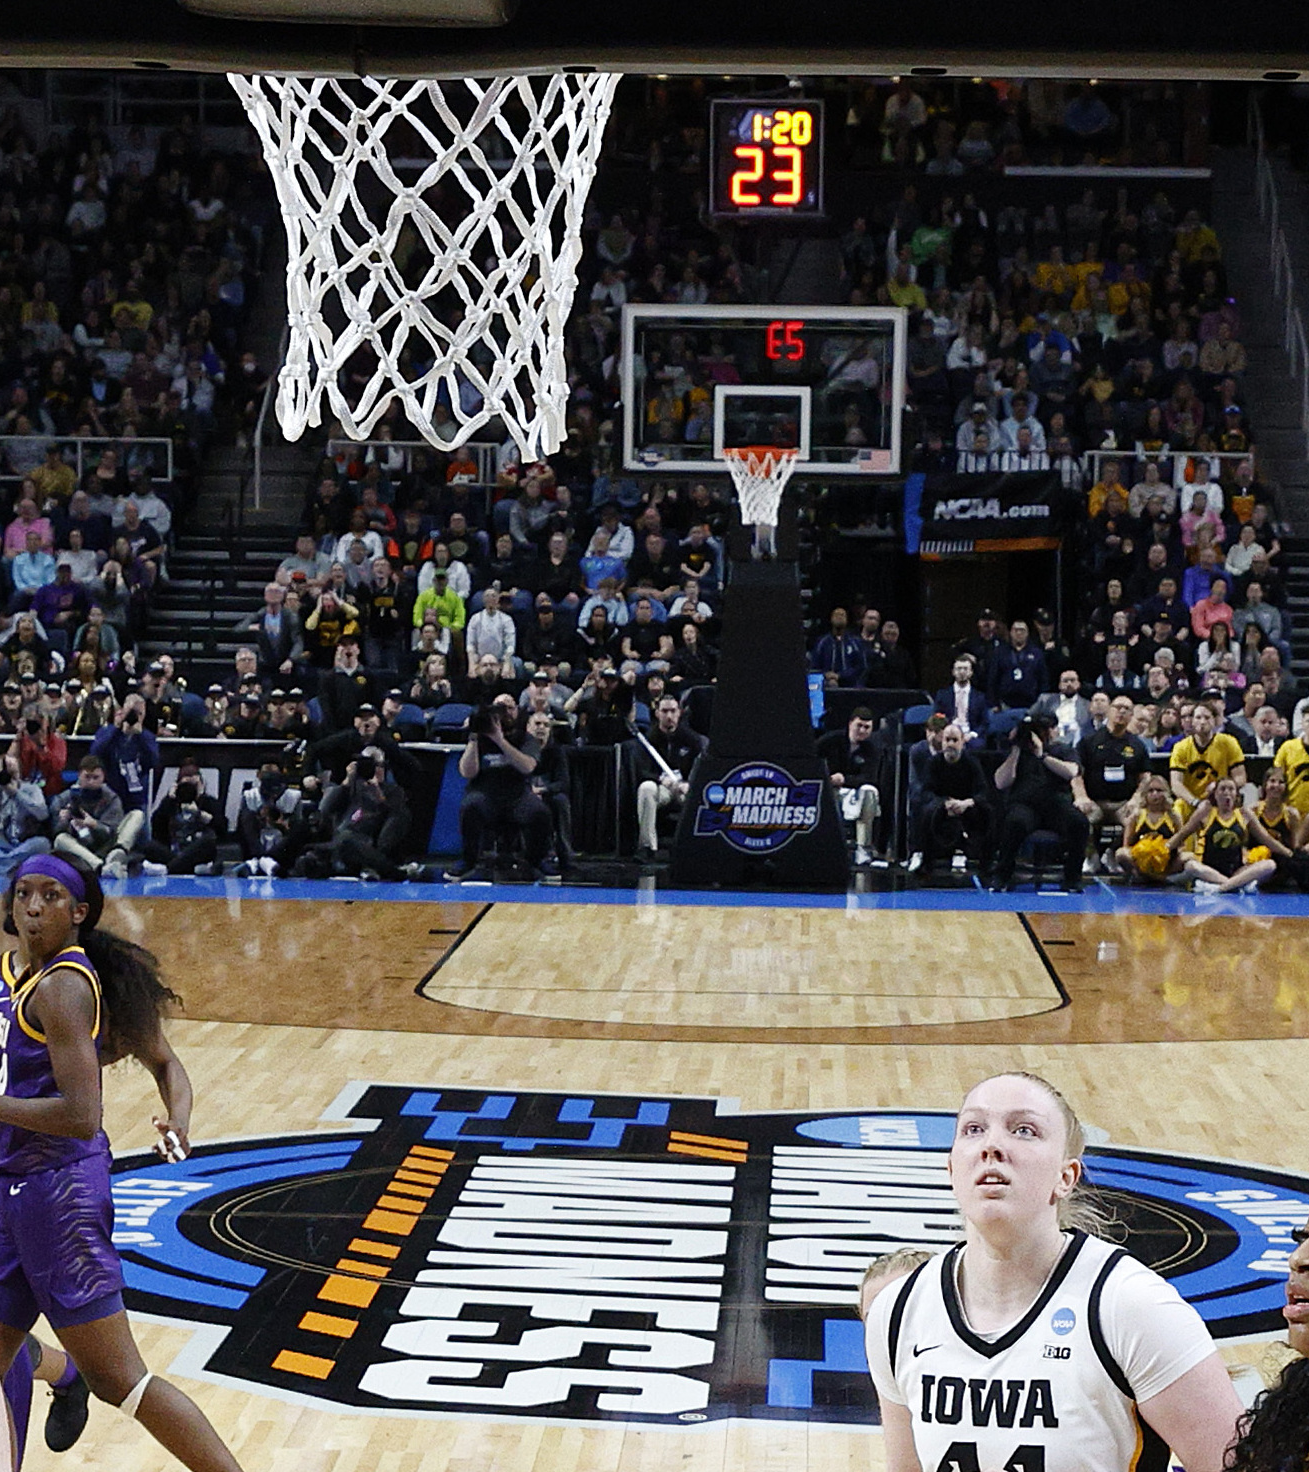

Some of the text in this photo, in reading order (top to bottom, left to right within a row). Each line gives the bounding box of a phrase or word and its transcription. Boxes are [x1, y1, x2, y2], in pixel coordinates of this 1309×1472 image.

[753, 111, 812, 146] 1:20
[729, 147, 803, 205] 23
[934, 498, 1050, 521] NCAA.com
[725, 787, 789, 806] MARCH
[732, 806, 817, 825] MADNESS
[357, 1155, 737, 1415] MADNESS
[921, 1374, 1059, 1429] IOWA
